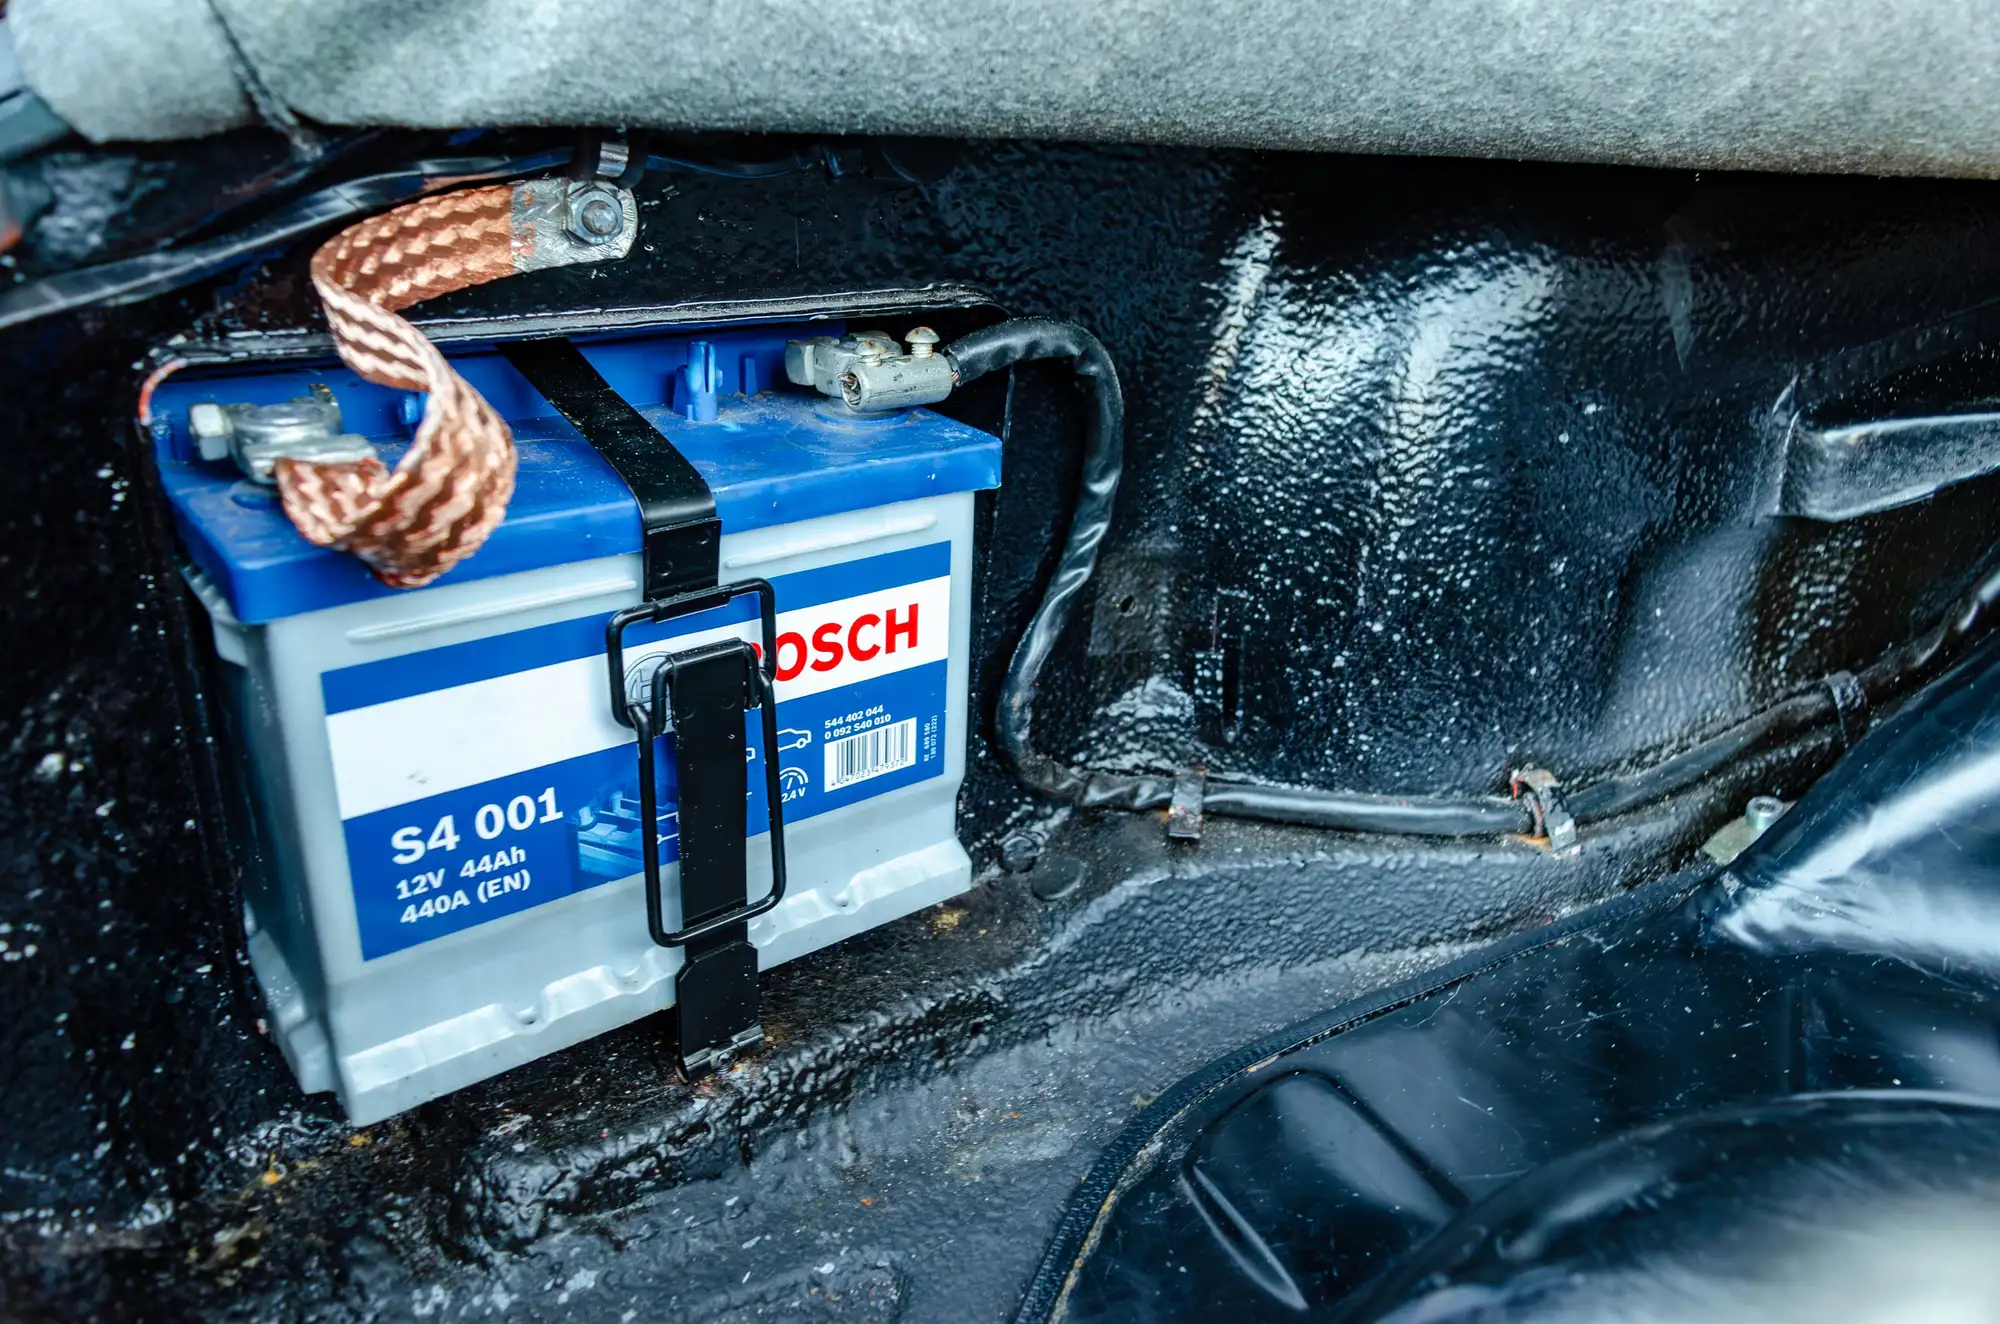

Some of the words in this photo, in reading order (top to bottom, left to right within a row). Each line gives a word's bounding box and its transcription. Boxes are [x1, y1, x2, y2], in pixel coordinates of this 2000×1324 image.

[750, 602, 919, 682] OSCH
[824, 716, 844, 729] 544
[845, 710, 864, 722] 402
[865, 704, 884, 717] 044
[824, 731, 832, 740] 0
[833, 725, 852, 737] 092
[853, 719, 873, 732] S40
[874, 713, 892, 726] 010
[781, 789, 797, 803] 2.4
[797, 786, 806, 798] V
[390, 814, 461, 865] S4
[474, 786, 564, 840] 001
[395, 867, 446, 900] 12V
[459, 845, 526, 878] 44Ah
[399, 889, 471, 924] 440A
[476, 868, 531, 904] (EN)
